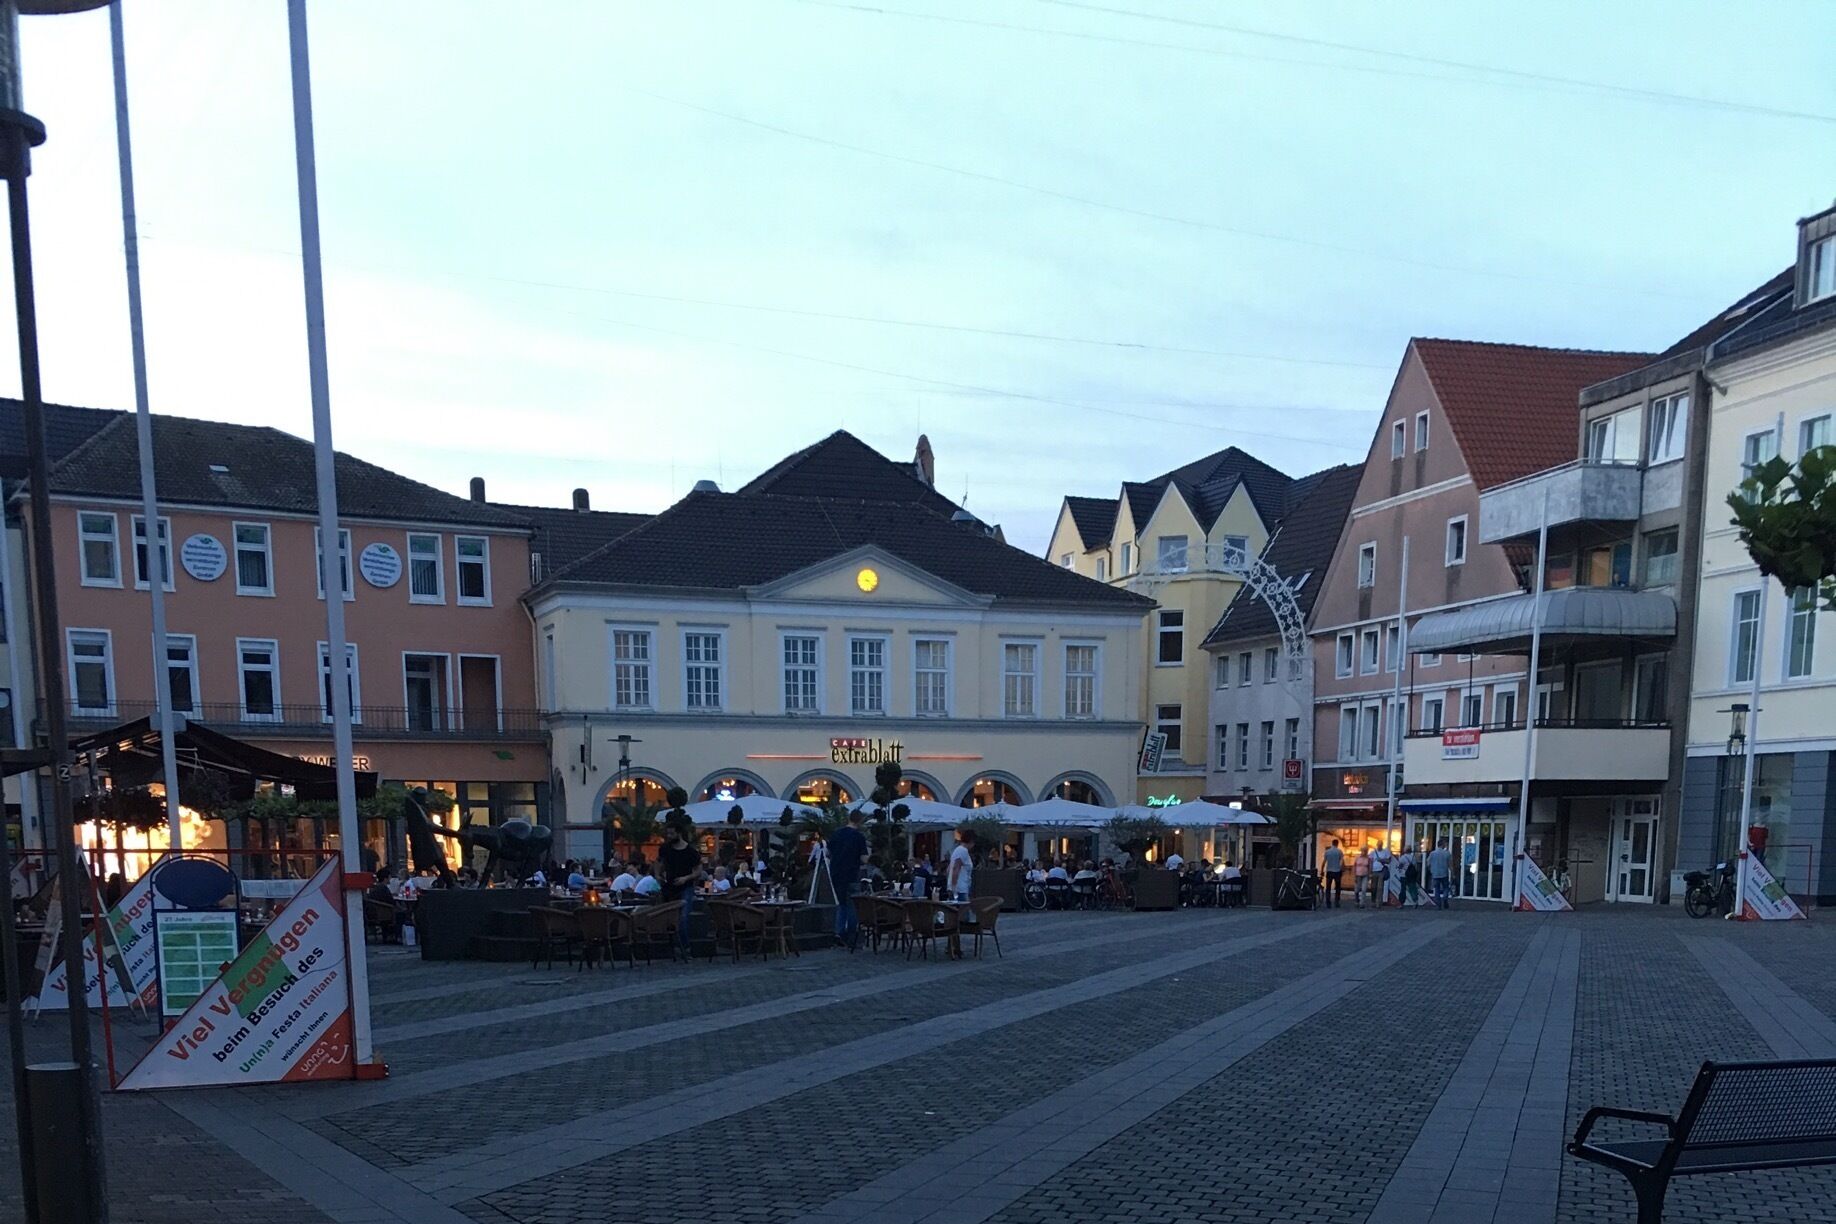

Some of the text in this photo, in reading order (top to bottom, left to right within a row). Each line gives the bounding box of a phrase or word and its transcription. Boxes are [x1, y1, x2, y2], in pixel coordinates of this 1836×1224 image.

[313, 757, 369, 770] WEER
[831, 739, 904, 763] extrablatt
[167, 1016, 215, 1060] Viel
[210, 906, 319, 1016] Vergnügen
[212, 946, 324, 1063] beim Besuch des
[239, 970, 338, 1073] Un(n)a Festa Italiana
[308, 1011, 329, 1032] Ihnen
